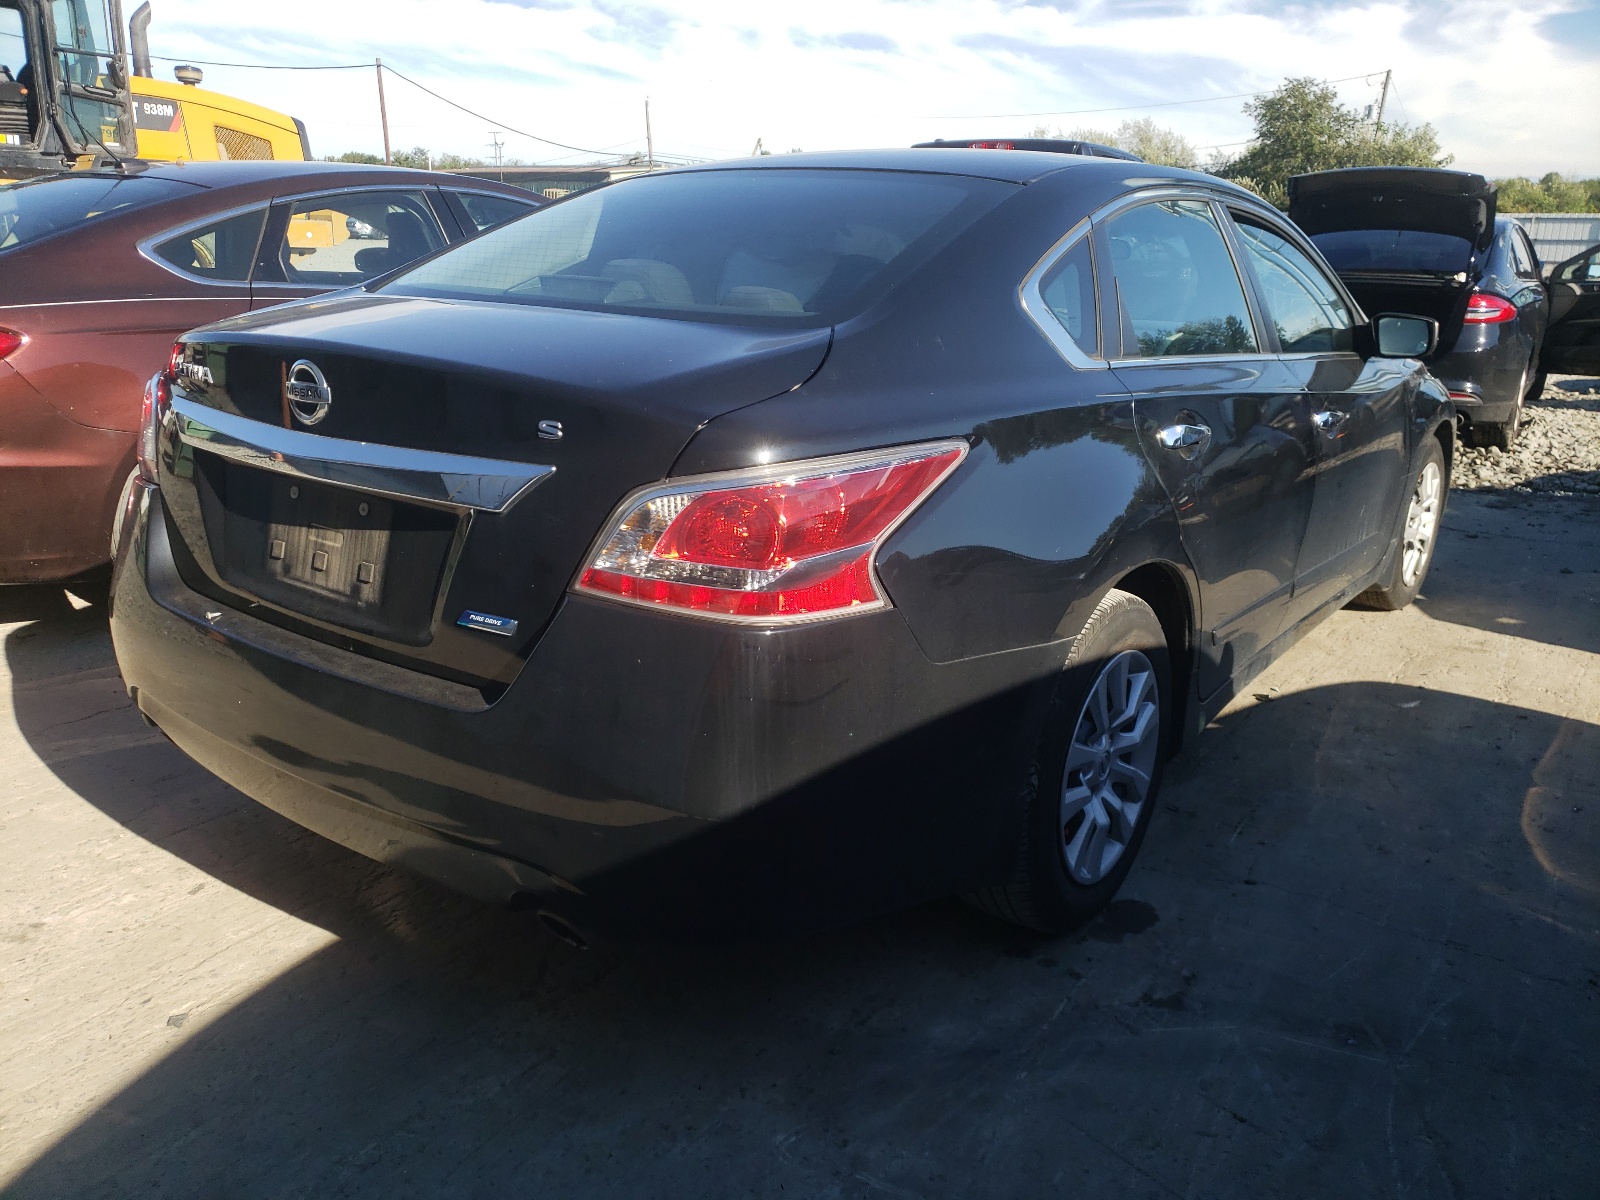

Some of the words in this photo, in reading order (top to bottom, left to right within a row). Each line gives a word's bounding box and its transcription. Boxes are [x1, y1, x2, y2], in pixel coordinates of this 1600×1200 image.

[143, 103, 174, 116] 938M
[286, 384, 322, 399] NISSAN
[537, 419, 563, 440] S
[469, 614, 484, 623] PURE
[484, 617, 503, 626] DRIVE
